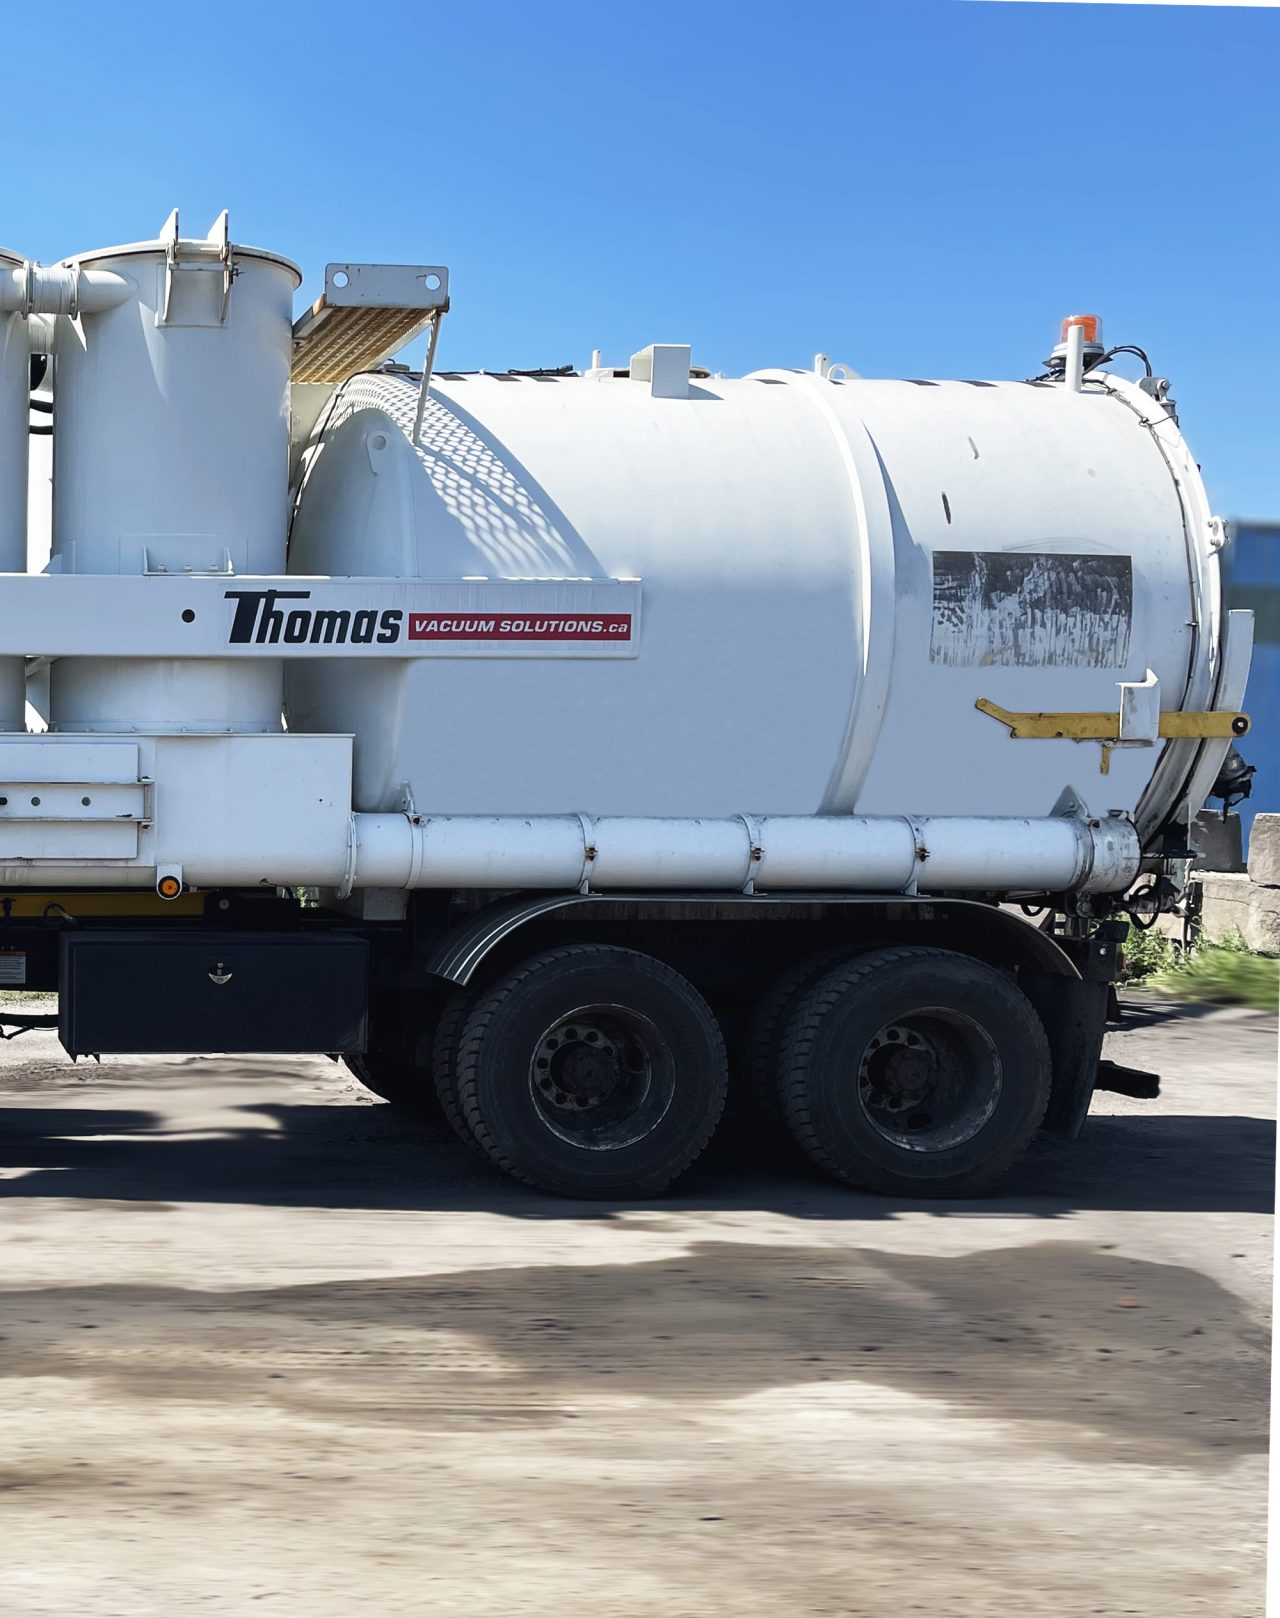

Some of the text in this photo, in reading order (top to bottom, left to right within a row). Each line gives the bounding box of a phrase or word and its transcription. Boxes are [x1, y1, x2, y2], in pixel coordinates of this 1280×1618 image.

[224, 589, 628, 644] Thomas VACUUM SOLUTIONS.ca
